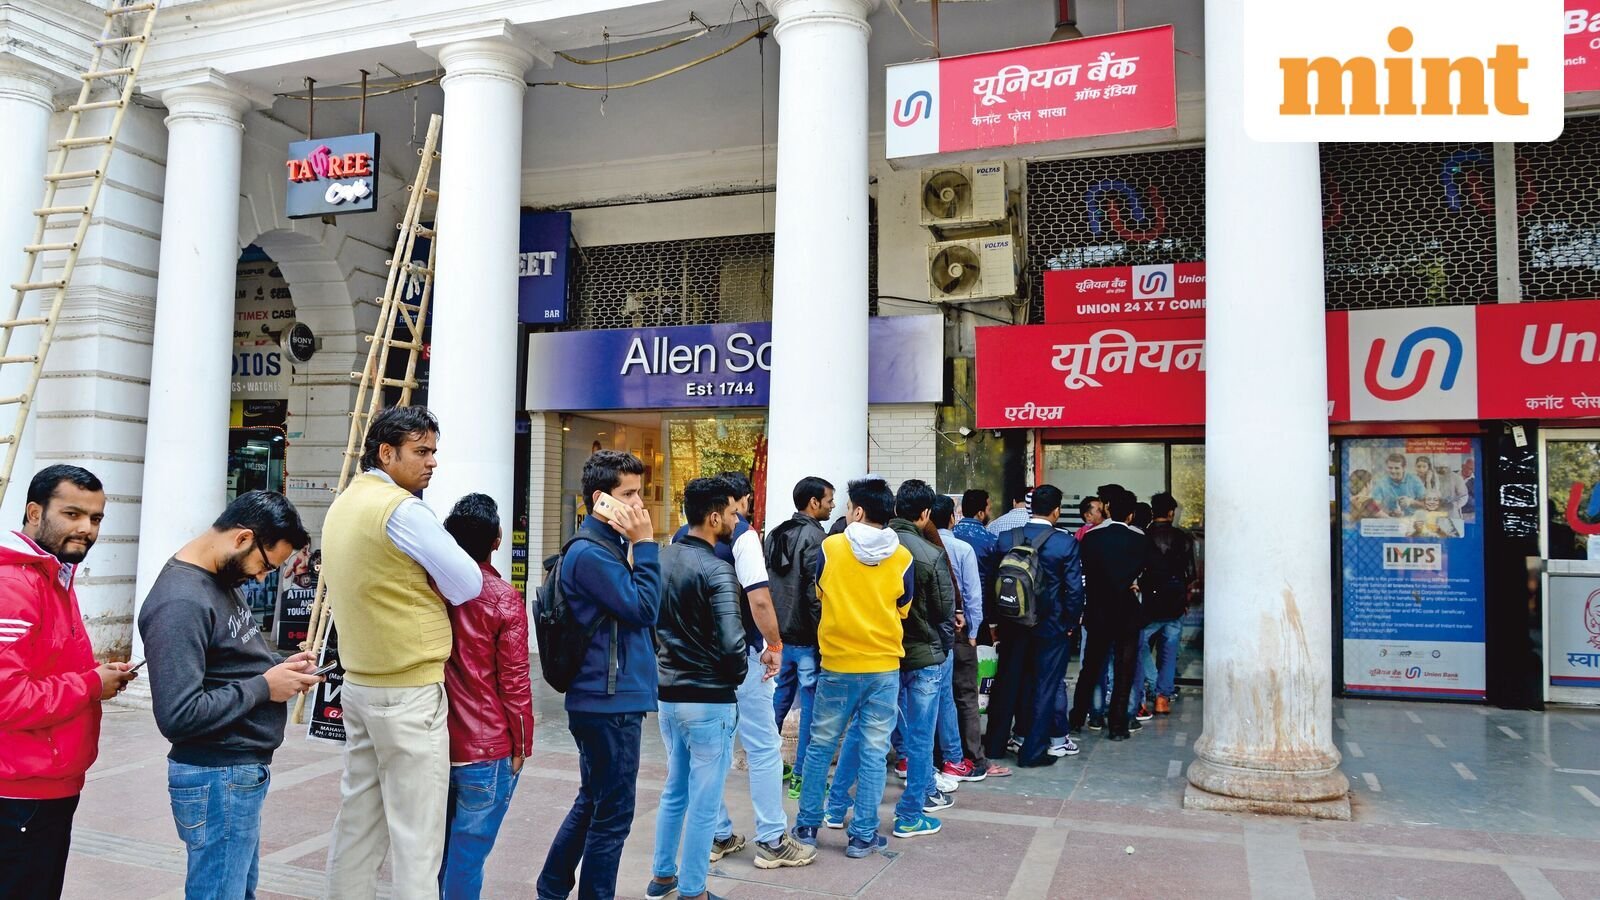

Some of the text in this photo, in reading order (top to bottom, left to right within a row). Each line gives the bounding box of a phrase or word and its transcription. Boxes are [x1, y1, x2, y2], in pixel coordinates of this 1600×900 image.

[972, 51, 1140, 106] यूनियन बैंक
[1074, 84, 1138, 101] ऑफ इंडिया
[1007, 108, 1031, 122] प्लेस
[1038, 106, 1067, 119] शाखा
[984, 241, 1009, 249] VOLTAS
[1075, 276, 1127, 293] यूनियन बैंक
[238, 311, 269, 320] TIMEX
[544, 310, 560, 318] BAR
[1076, 303, 1120, 315] UNION
[1124, 302, 1141, 312] 24
[1144, 301, 1154, 312] X
[1158, 301, 1165, 311] 7
[292, 336, 312, 345] SONY
[1520, 323, 1600, 365] Un
[620, 336, 716, 375] Allen
[1051, 329, 1206, 390] यूनियन
[247, 381, 281, 392] WATCHES
[686, 381, 754, 396] Est 1744
[1525, 394, 1564, 410] कनॉट
[1004, 402, 1065, 421] एटीएम
[1386, 546, 1436, 564] IMPS
